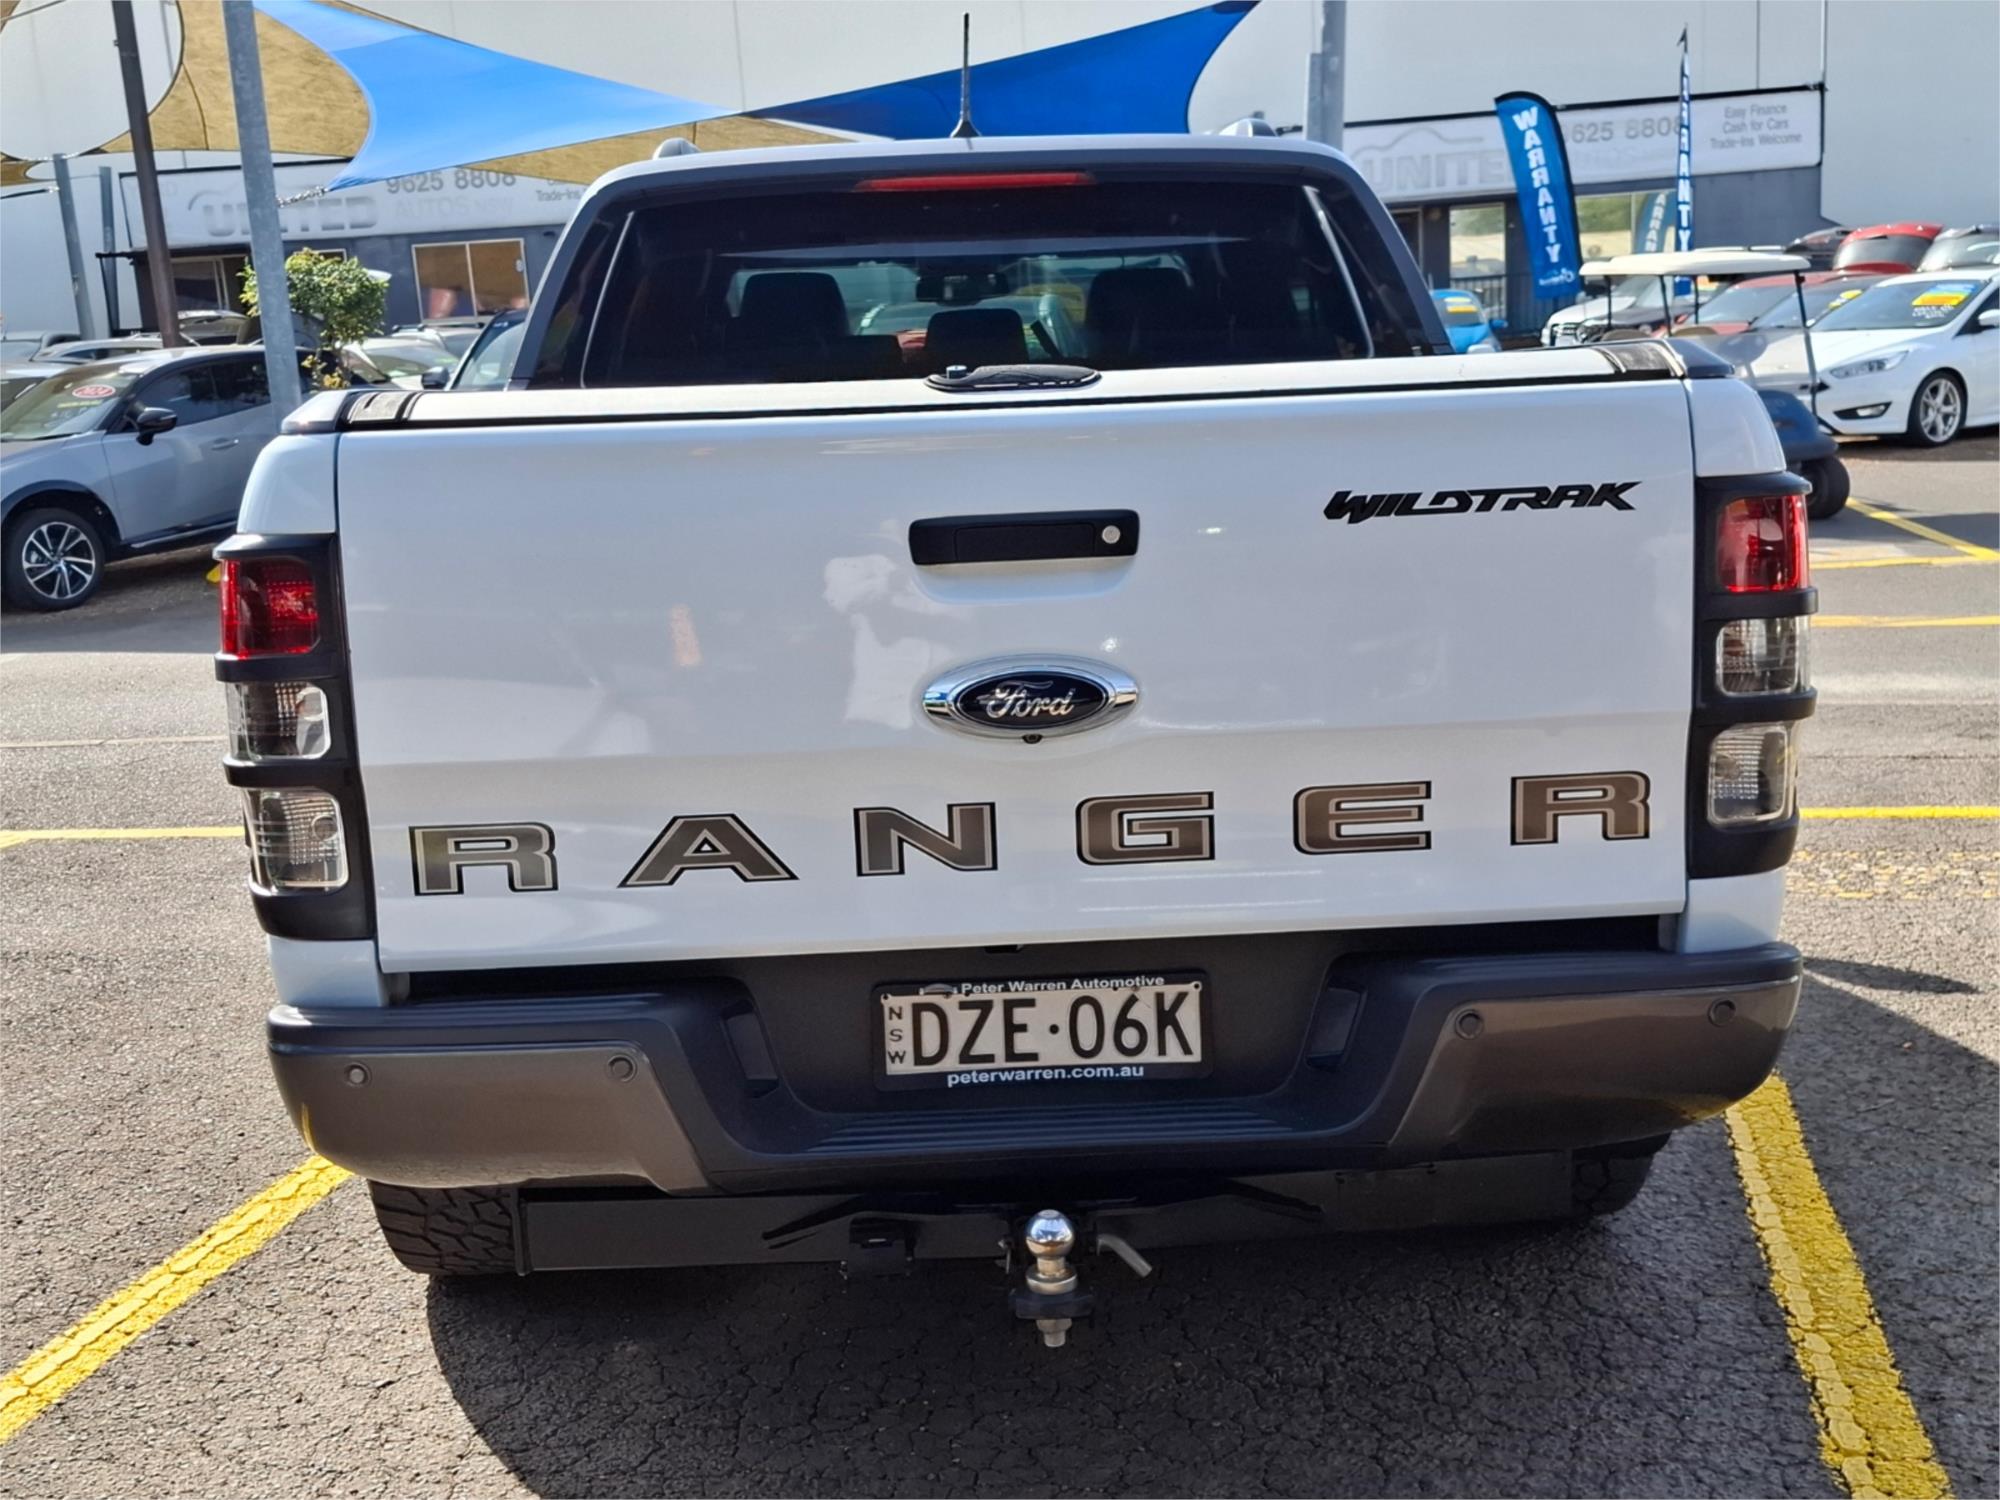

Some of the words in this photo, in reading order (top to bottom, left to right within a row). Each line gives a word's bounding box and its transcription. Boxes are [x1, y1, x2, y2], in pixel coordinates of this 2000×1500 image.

[1570, 120, 1614, 144] 625
[1722, 120, 1747, 134] Cash
[1767, 117, 1789, 130] Cars
[386, 171, 444, 194] 9625
[1362, 148, 1508, 192] UNITE
[202, 196, 377, 238] UTED
[1323, 481, 1642, 525] WILDTRAK
[978, 680, 1077, 719] Ford
[409, 770, 1651, 897] RANGER
[960, 982, 1003, 995] Peter
[1007, 978, 1069, 993] Warren
[1071, 975, 1165, 991] Automotive
[888, 1005, 907, 1065] NSW
[947, 1064, 1145, 1088] peterwarren.com.au
